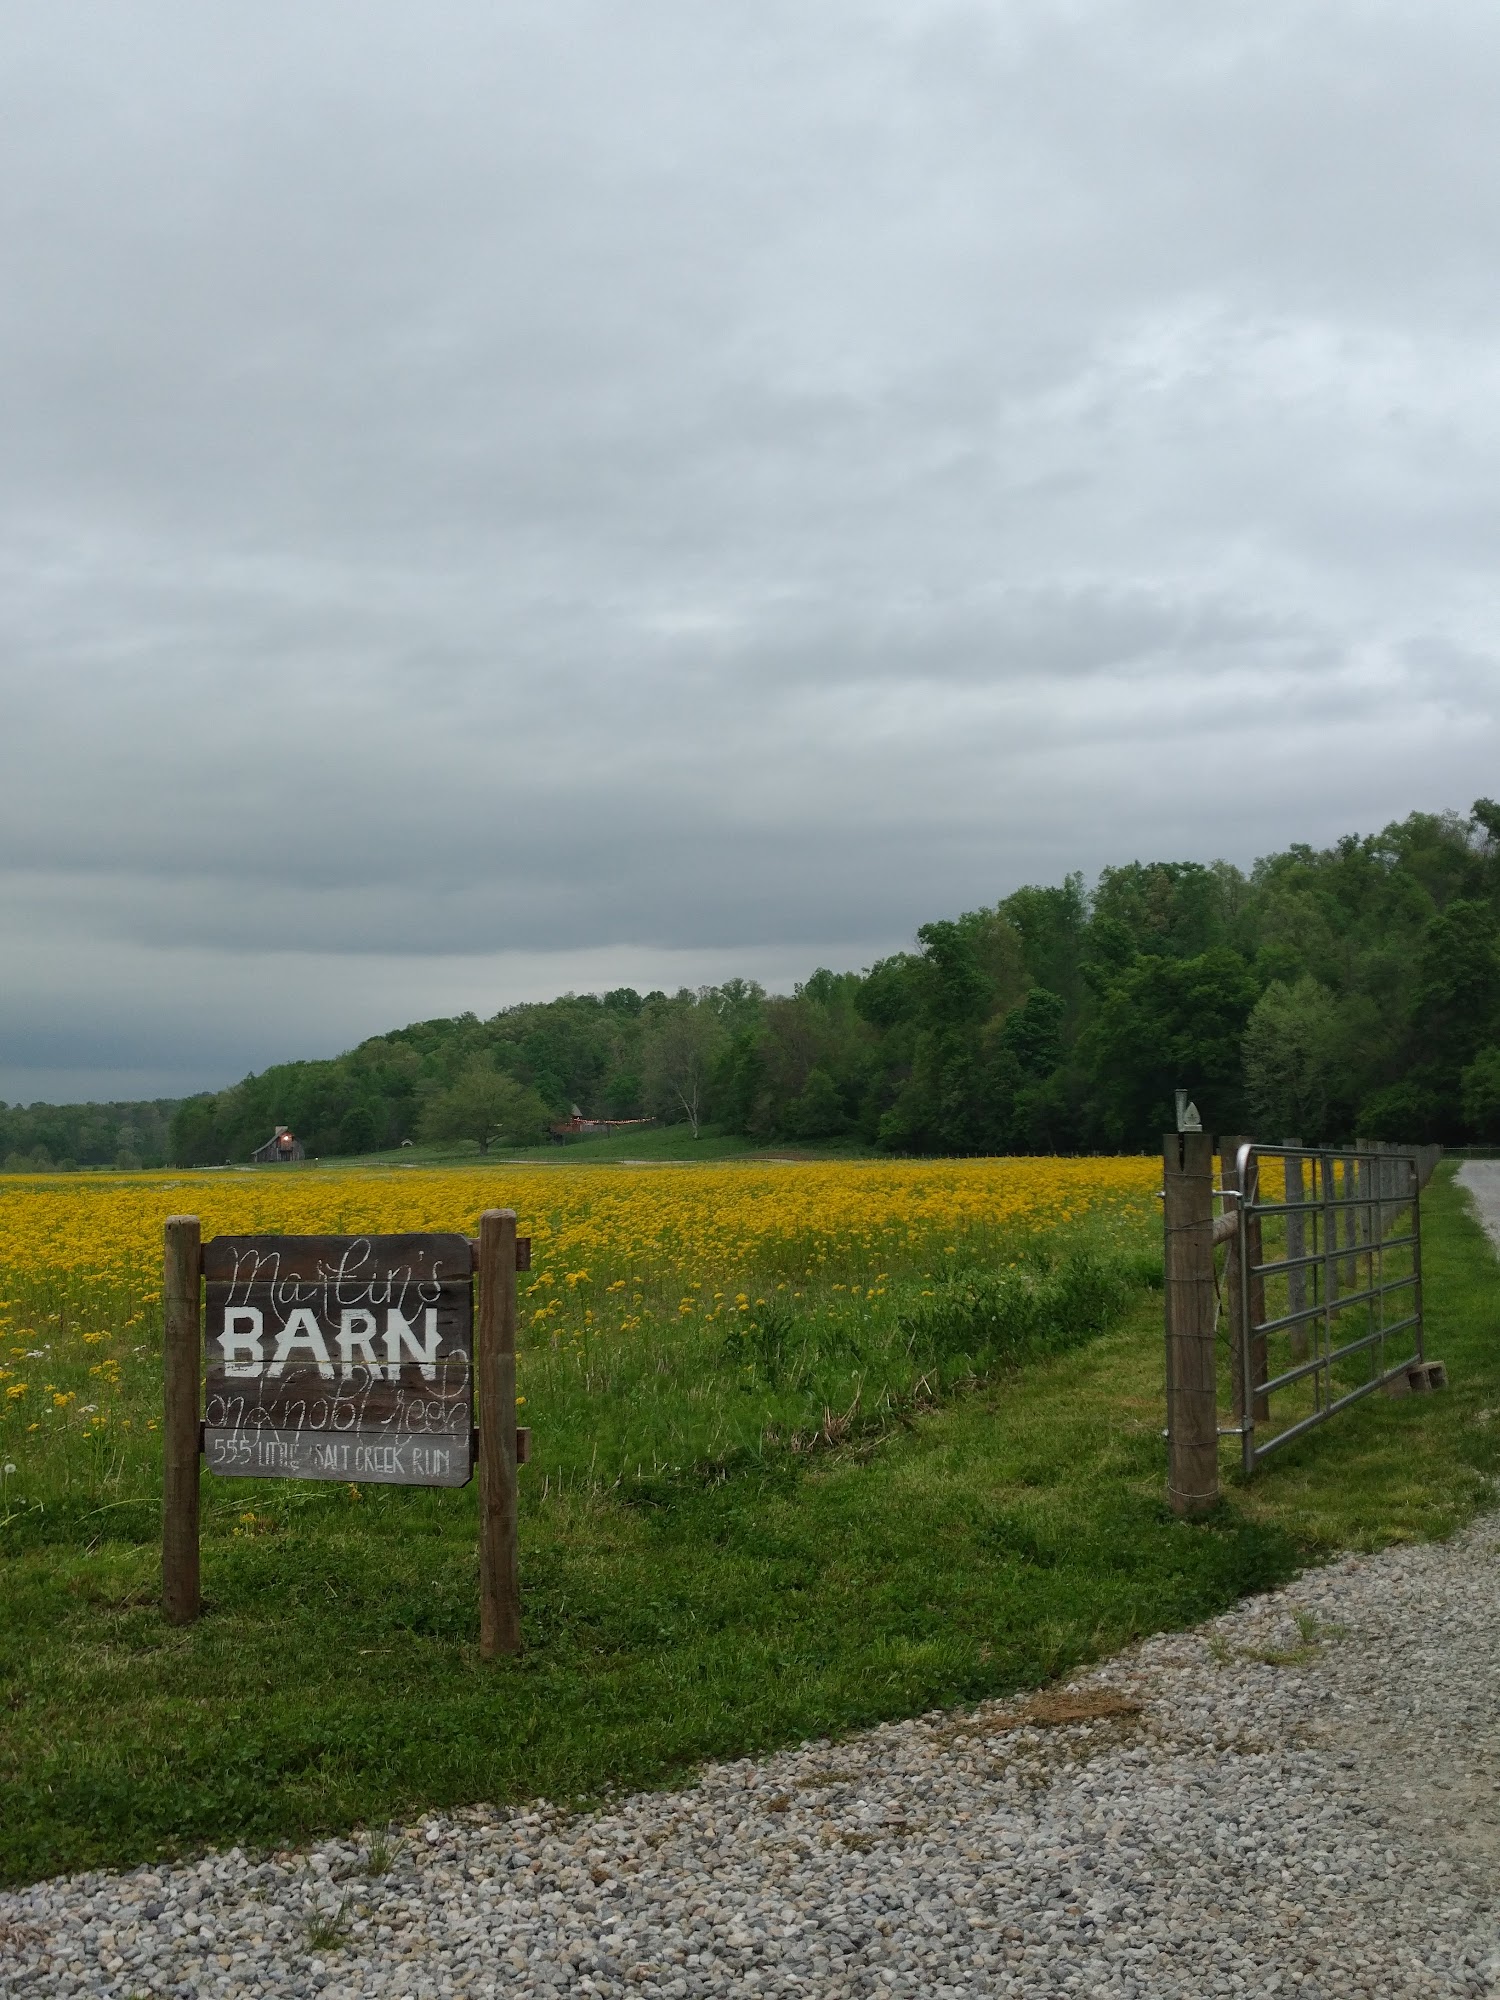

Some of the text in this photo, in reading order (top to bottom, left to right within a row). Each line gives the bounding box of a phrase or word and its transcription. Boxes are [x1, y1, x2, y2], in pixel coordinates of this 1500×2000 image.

[225, 1239, 444, 1329] Martin's
[217, 1306, 444, 1380] BARN
[213, 1439, 252, 1464] 555
[355, 1446, 405, 1474] CREEK
[412, 1448, 450, 1477] RUN
